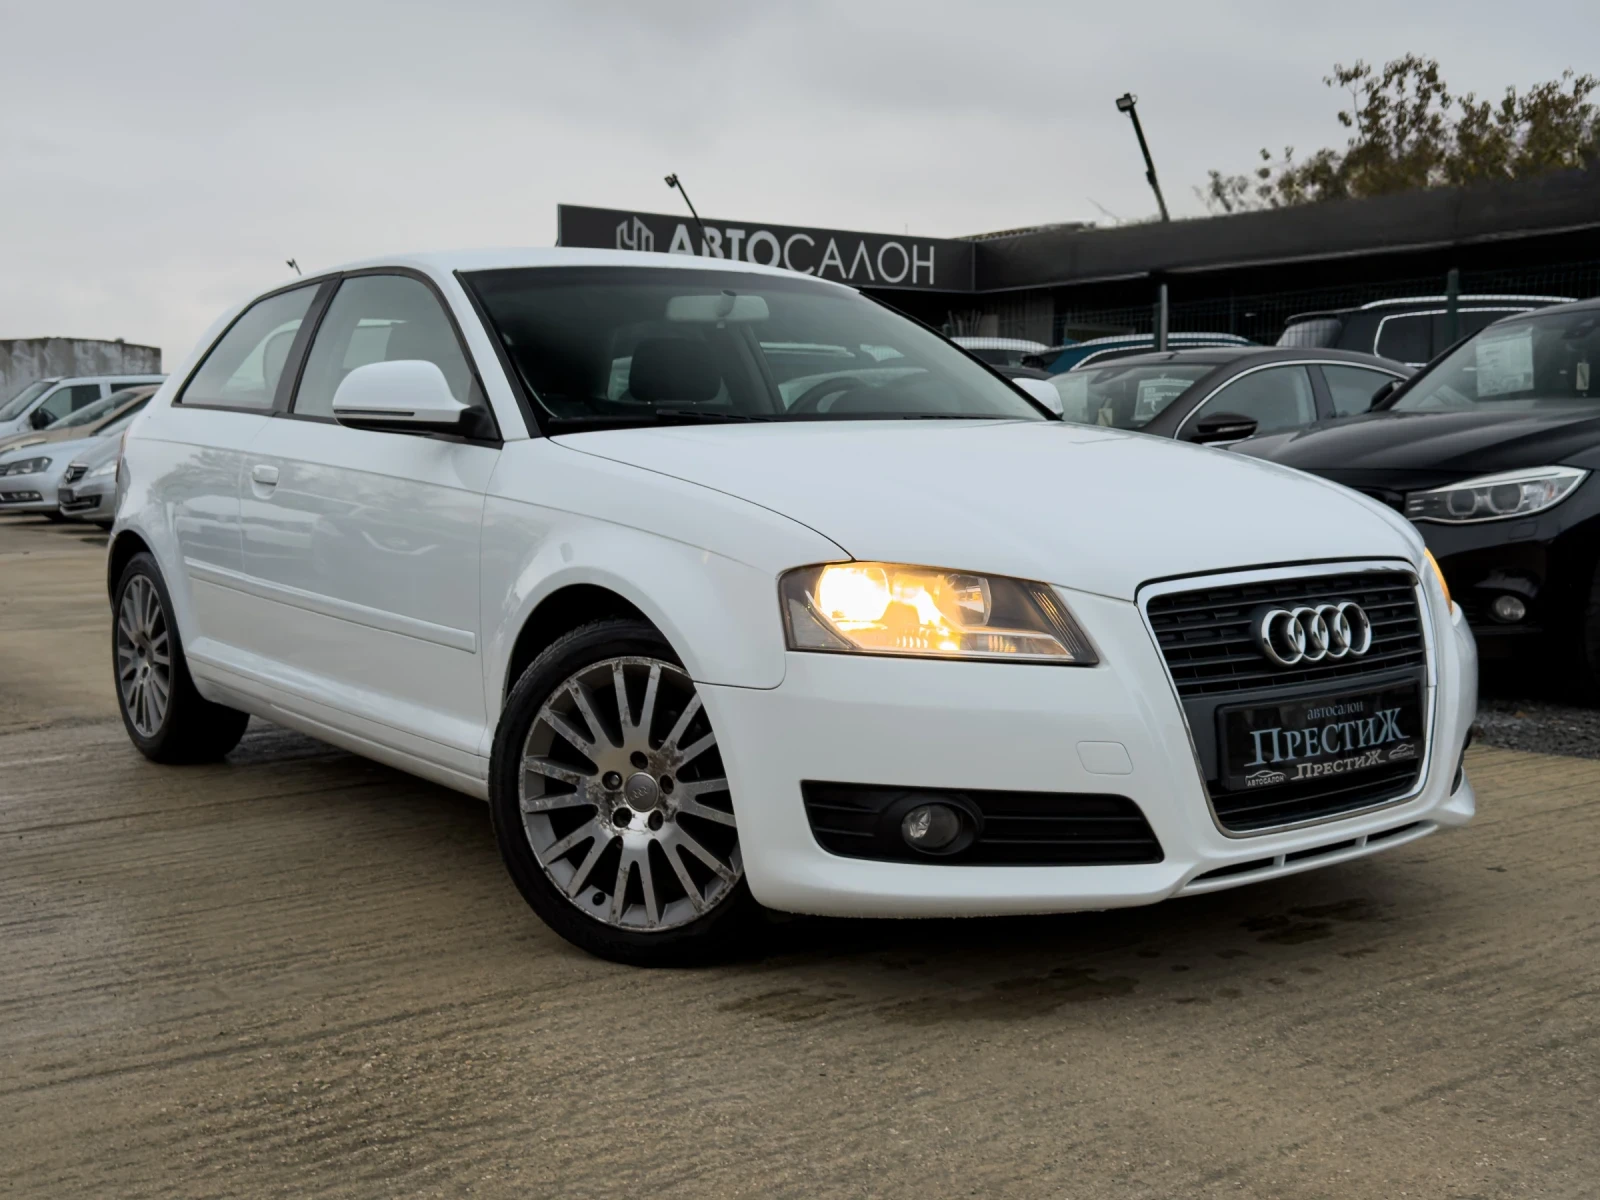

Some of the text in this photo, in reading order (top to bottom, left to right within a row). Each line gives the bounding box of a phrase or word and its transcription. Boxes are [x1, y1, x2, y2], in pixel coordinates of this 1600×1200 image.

[668, 223, 936, 285] АВТОСАЛОН
[1307, 700, 1364, 720] автосалон
[1244, 707, 1410, 767] ПРЕСТИЖ
[1290, 749, 1386, 781] ПРЕСТИЖ
